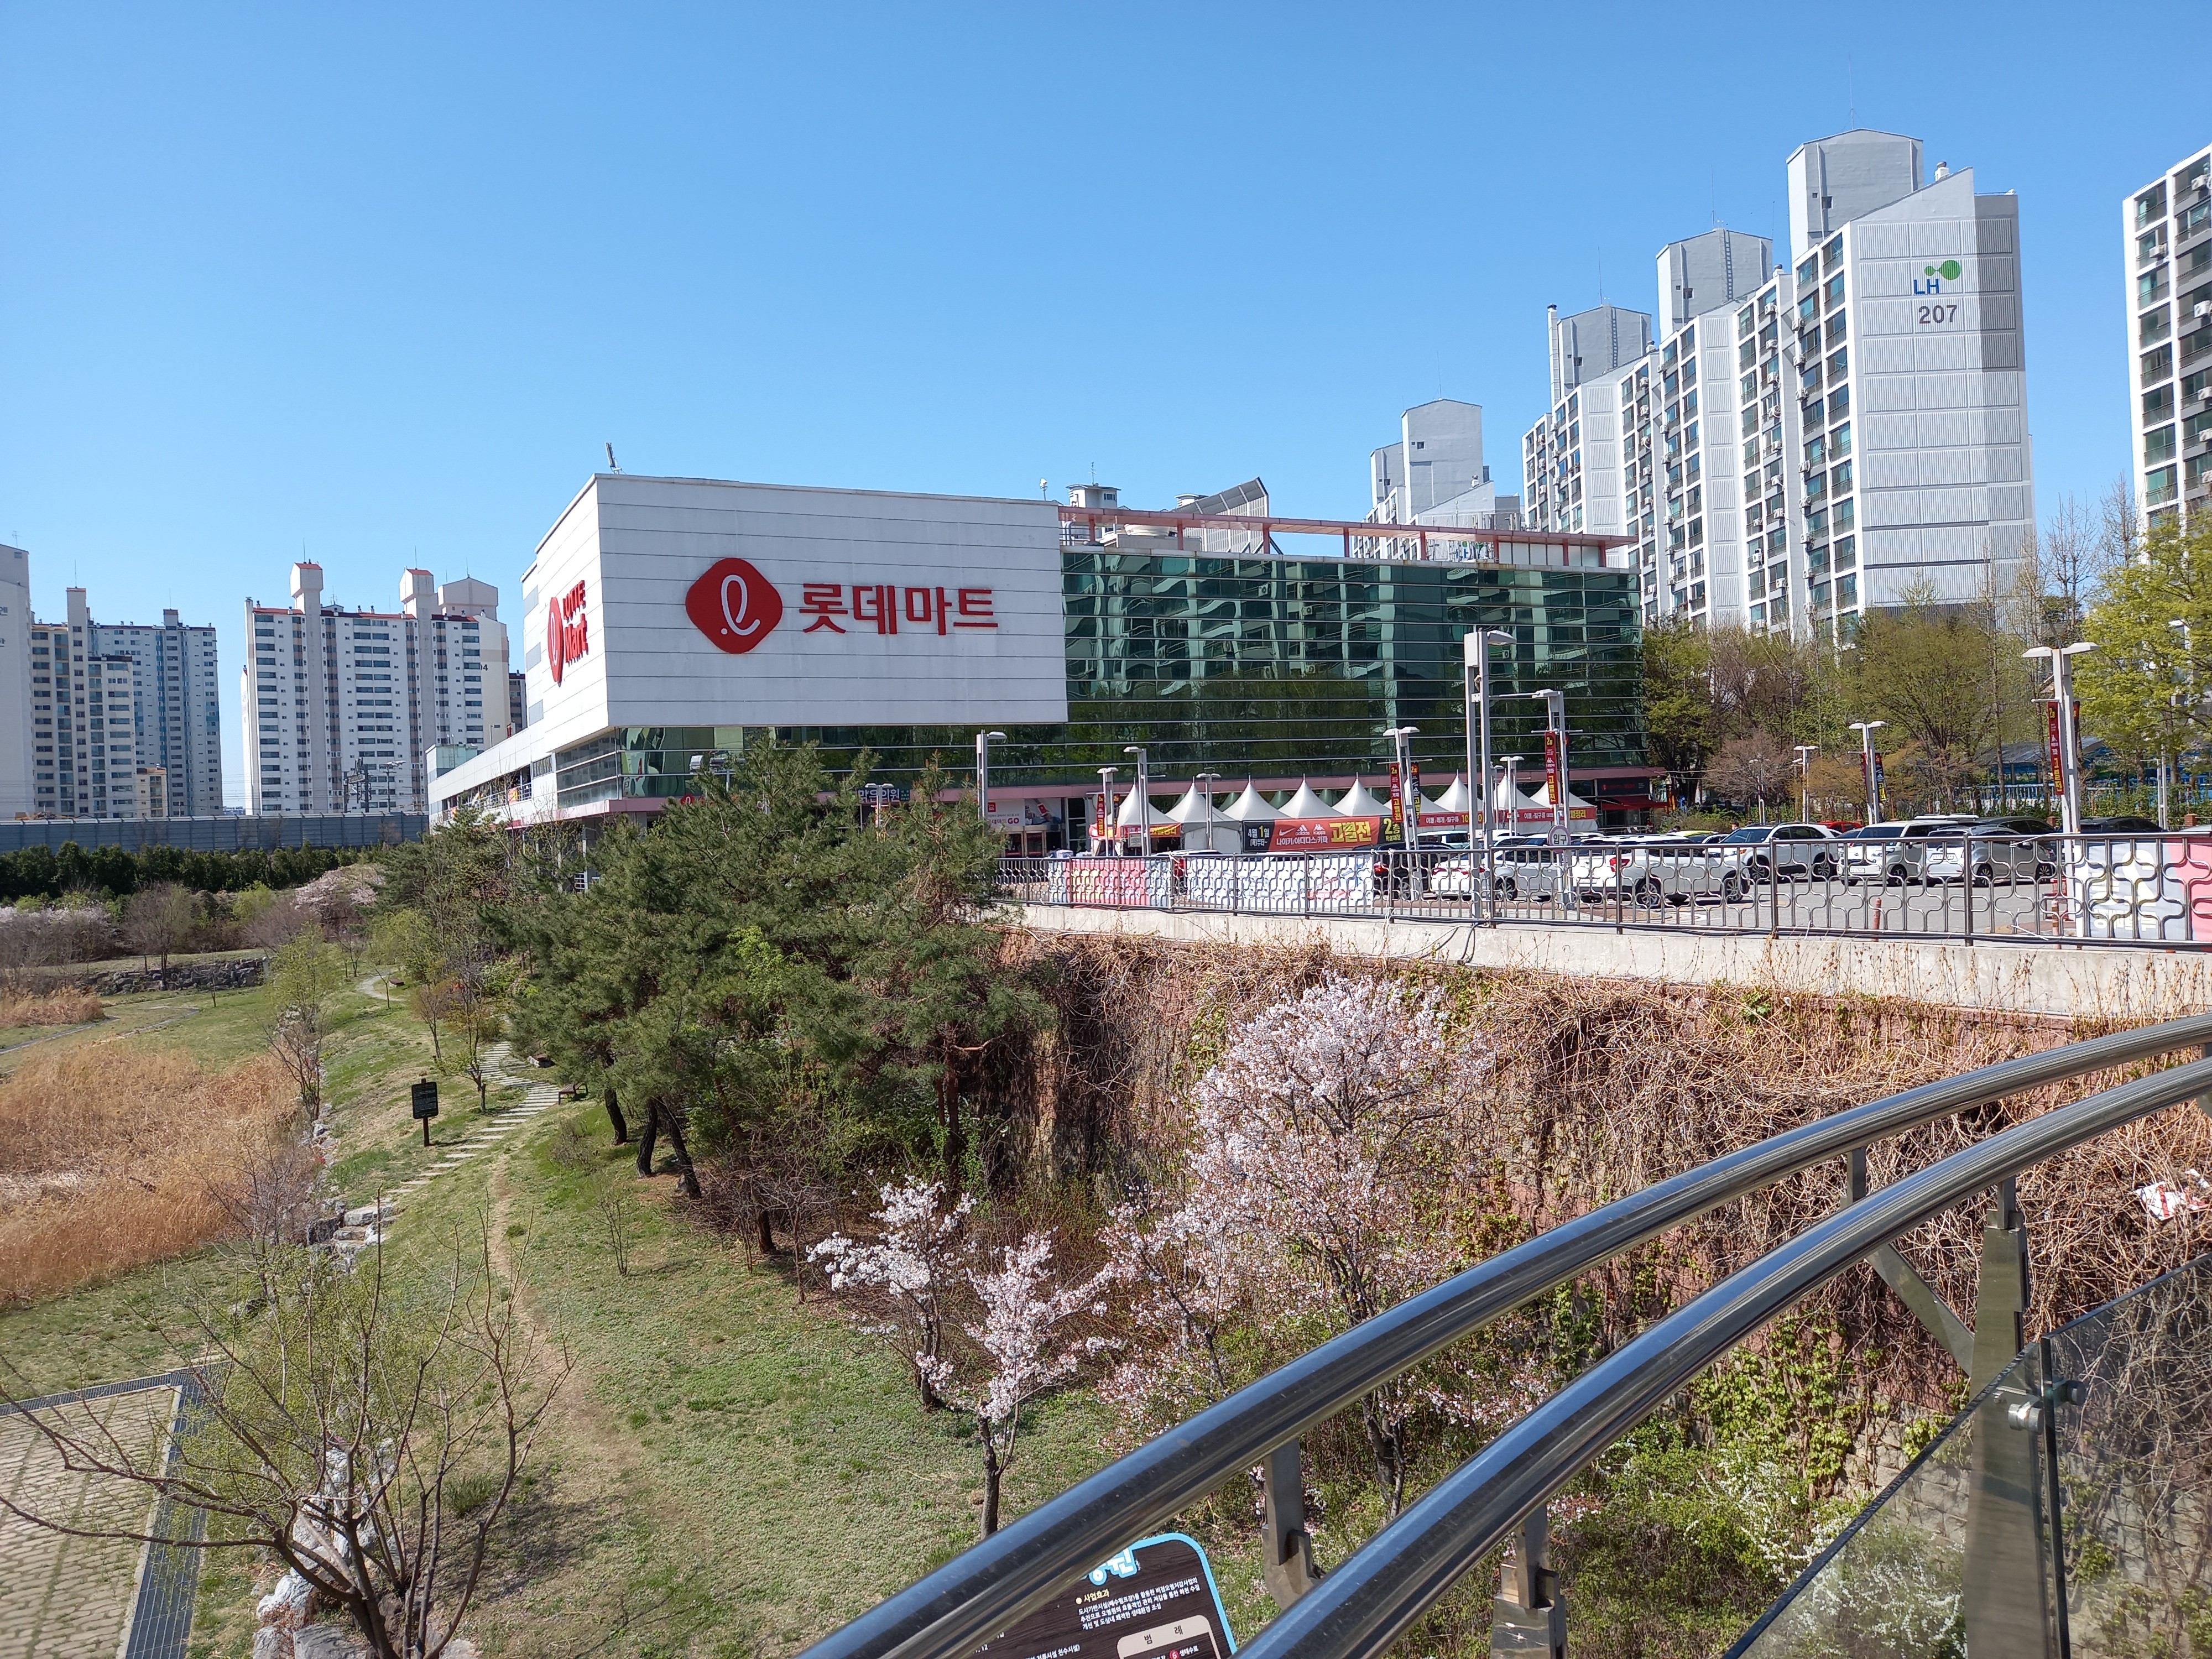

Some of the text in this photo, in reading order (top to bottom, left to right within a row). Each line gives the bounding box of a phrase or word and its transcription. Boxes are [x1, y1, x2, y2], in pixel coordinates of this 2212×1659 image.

[1913, 278, 1940, 295] LH
[1918, 305, 1958, 324] 207
[562, 580, 586, 621] LOTTE
[799, 583, 998, 635] 롯데마트
[565, 613, 588, 664] Mart
[1569, 810, 1587, 819] 별정리
[1248, 825, 1270, 838] 4월 1일
[1329, 821, 1372, 843] 고별전
[1384, 818, 1400, 834] 2층
[1276, 836, 1328, 846] 나이키/아디다스/카파
[1553, 834, 1567, 844] 입구
[1084, 1588, 1110, 1603] 사업효과
